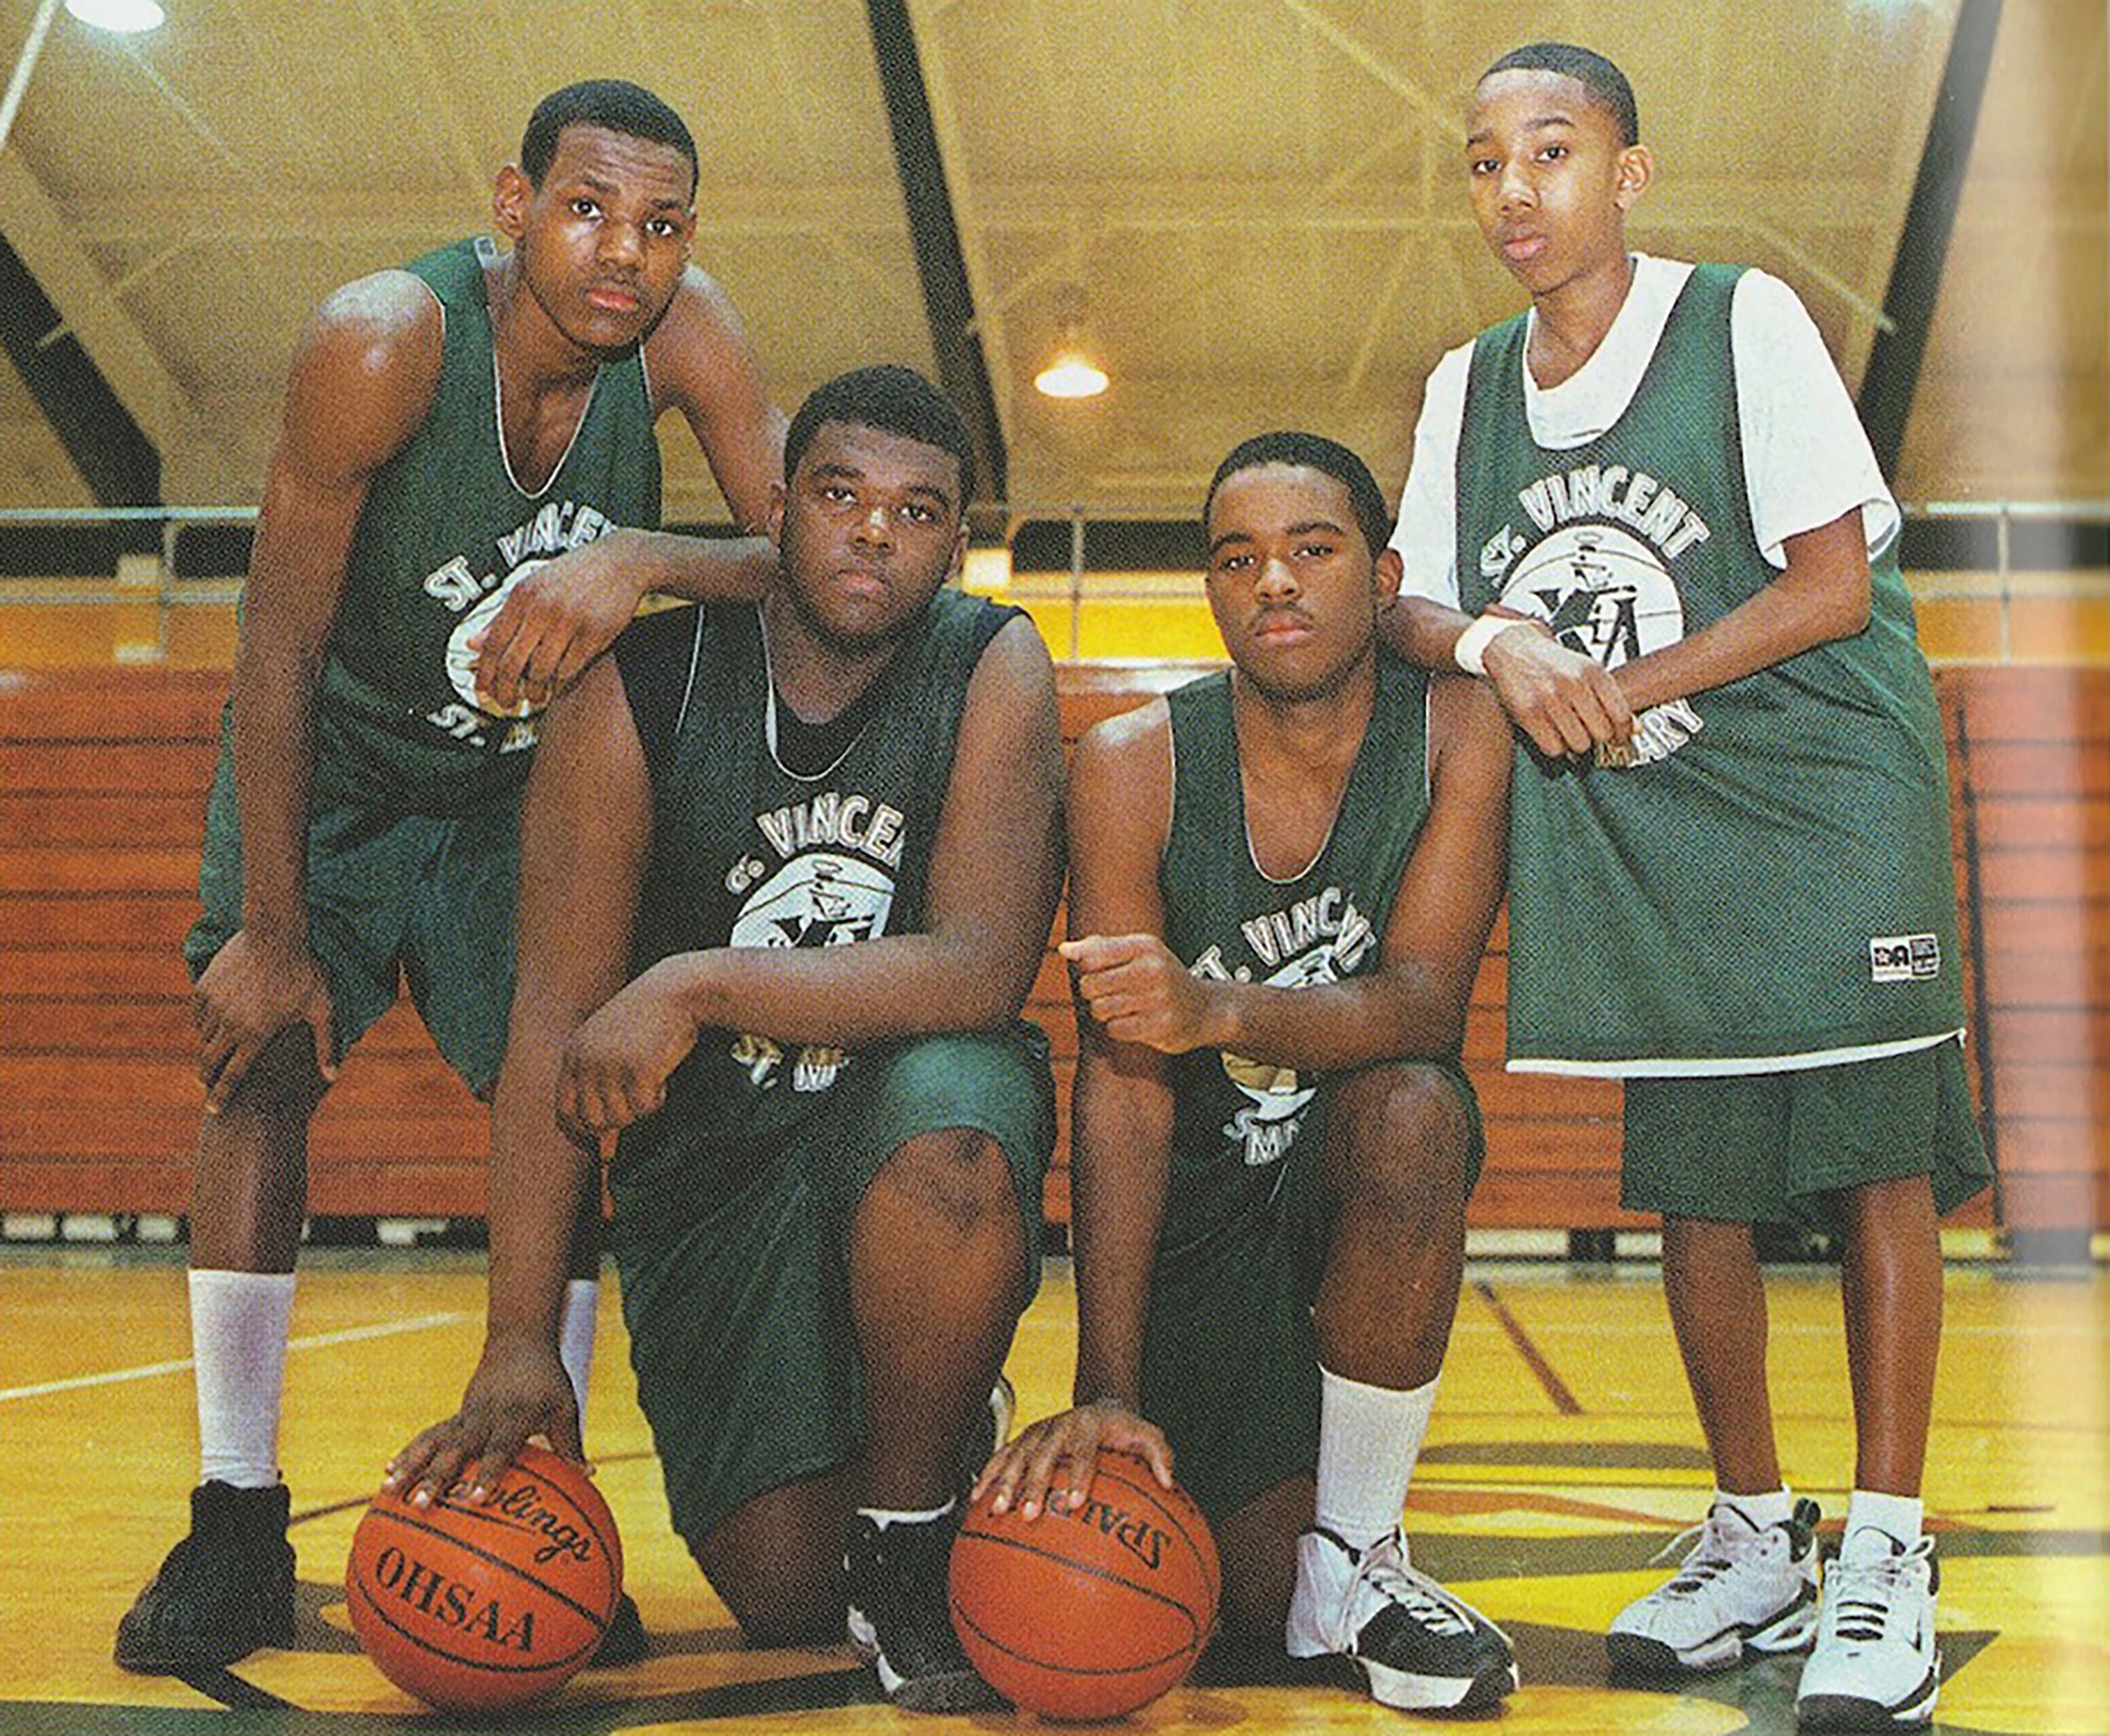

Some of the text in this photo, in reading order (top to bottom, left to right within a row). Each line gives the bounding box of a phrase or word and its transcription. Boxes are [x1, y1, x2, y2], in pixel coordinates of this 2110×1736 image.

[1518, 465, 1710, 560] VINCENT
[424, 554, 496, 611] ST.
[1594, 698, 1703, 768] MARY
[1188, 944, 1252, 985] T.
[376, 1546, 535, 1652] OHSAA
